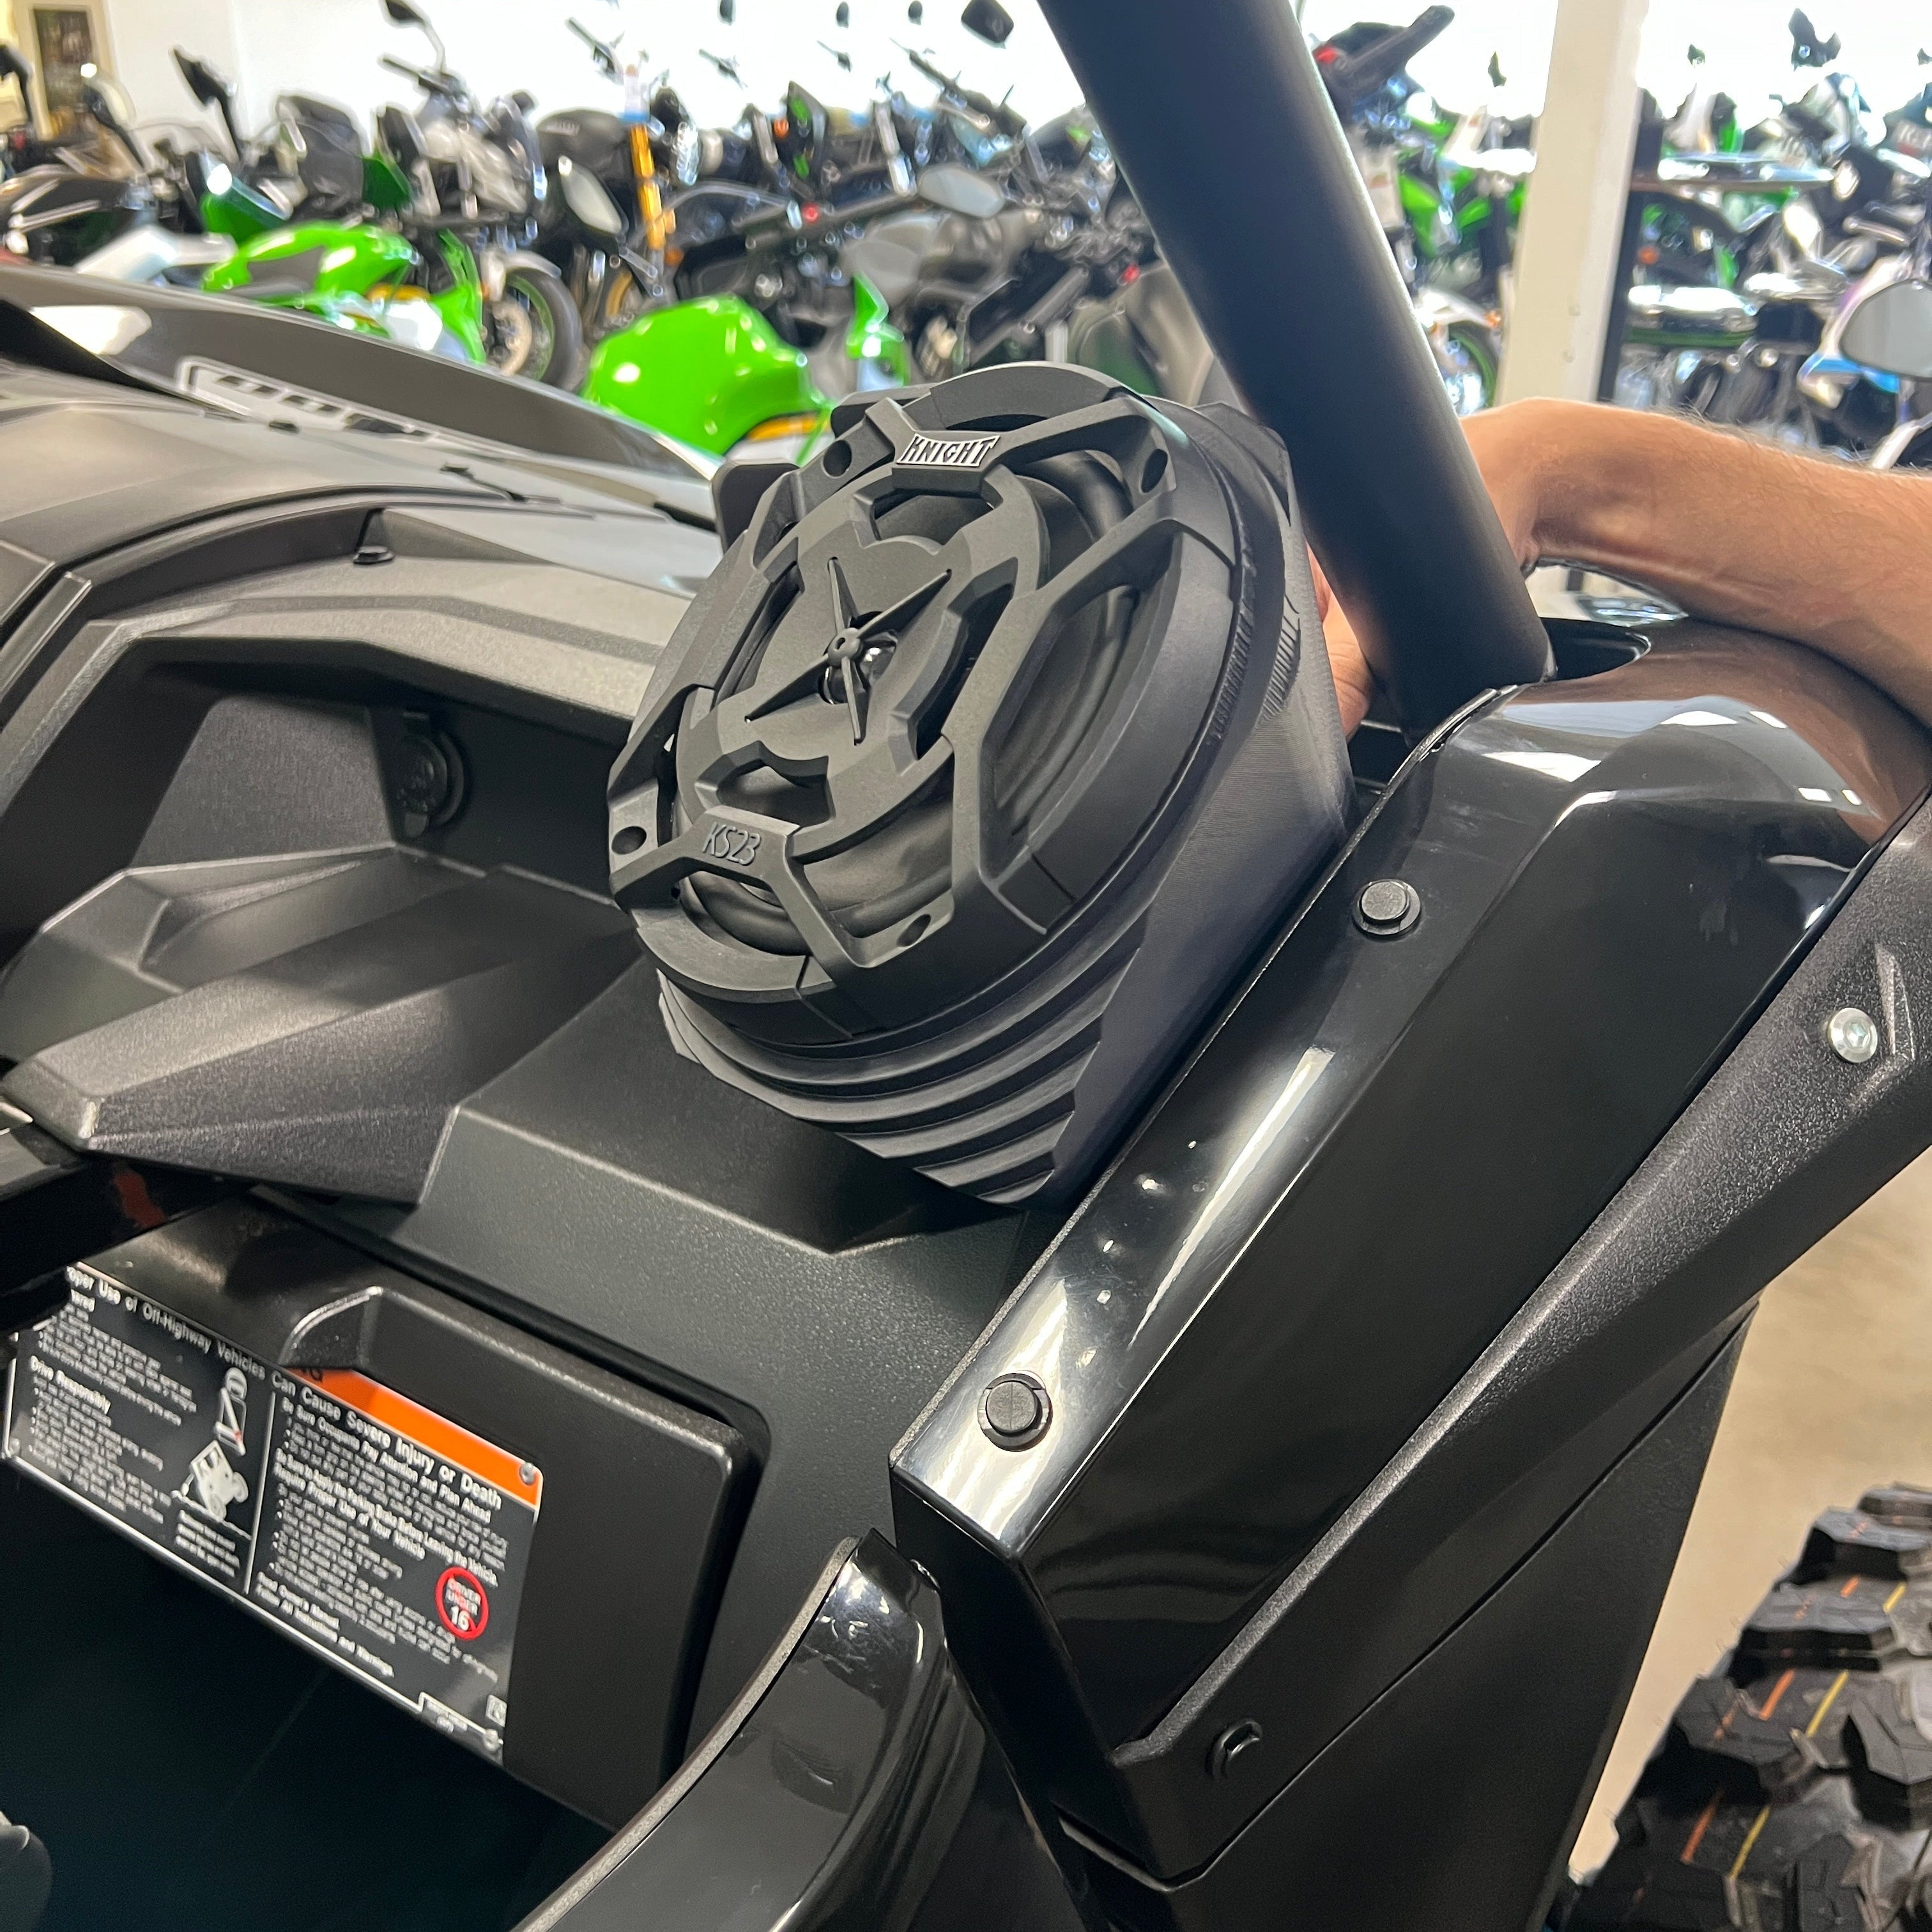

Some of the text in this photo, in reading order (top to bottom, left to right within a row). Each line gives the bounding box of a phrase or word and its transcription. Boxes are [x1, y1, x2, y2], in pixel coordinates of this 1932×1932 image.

[900, 435, 996, 465] KNIGHT
[703, 822, 762, 866] KS23
[30, 1356, 54, 1380] Drive
[67, 1266, 95, 1291] oper
[99, 1278, 121, 1305] Use
[125, 1295, 137, 1313] of
[142, 1302, 211, 1354] Off-Highway
[218, 1342, 266, 1380] Vehicles
[272, 1372, 296, 1397] Can
[302, 1386, 341, 1421] Cause
[347, 1411, 391, 1449] Severe
[395, 1438, 434, 1476] Injury
[439, 1466, 456, 1483] or
[461, 1473, 502, 1510] Death
[296, 1405, 315, 1425] Sure
[362, 1441, 379, 1463] Pay
[379, 1452, 418, 1482] Attention
[420, 1473, 438, 1493] and
[439, 1484, 459, 1506] Plan
[461, 1498, 491, 1524] Ahead
[338, 1499, 356, 1519] Use
[357, 1513, 371, 1526] of
[394, 1530, 425, 1559] Vehicle
[450, 1606, 470, 1632] 16
